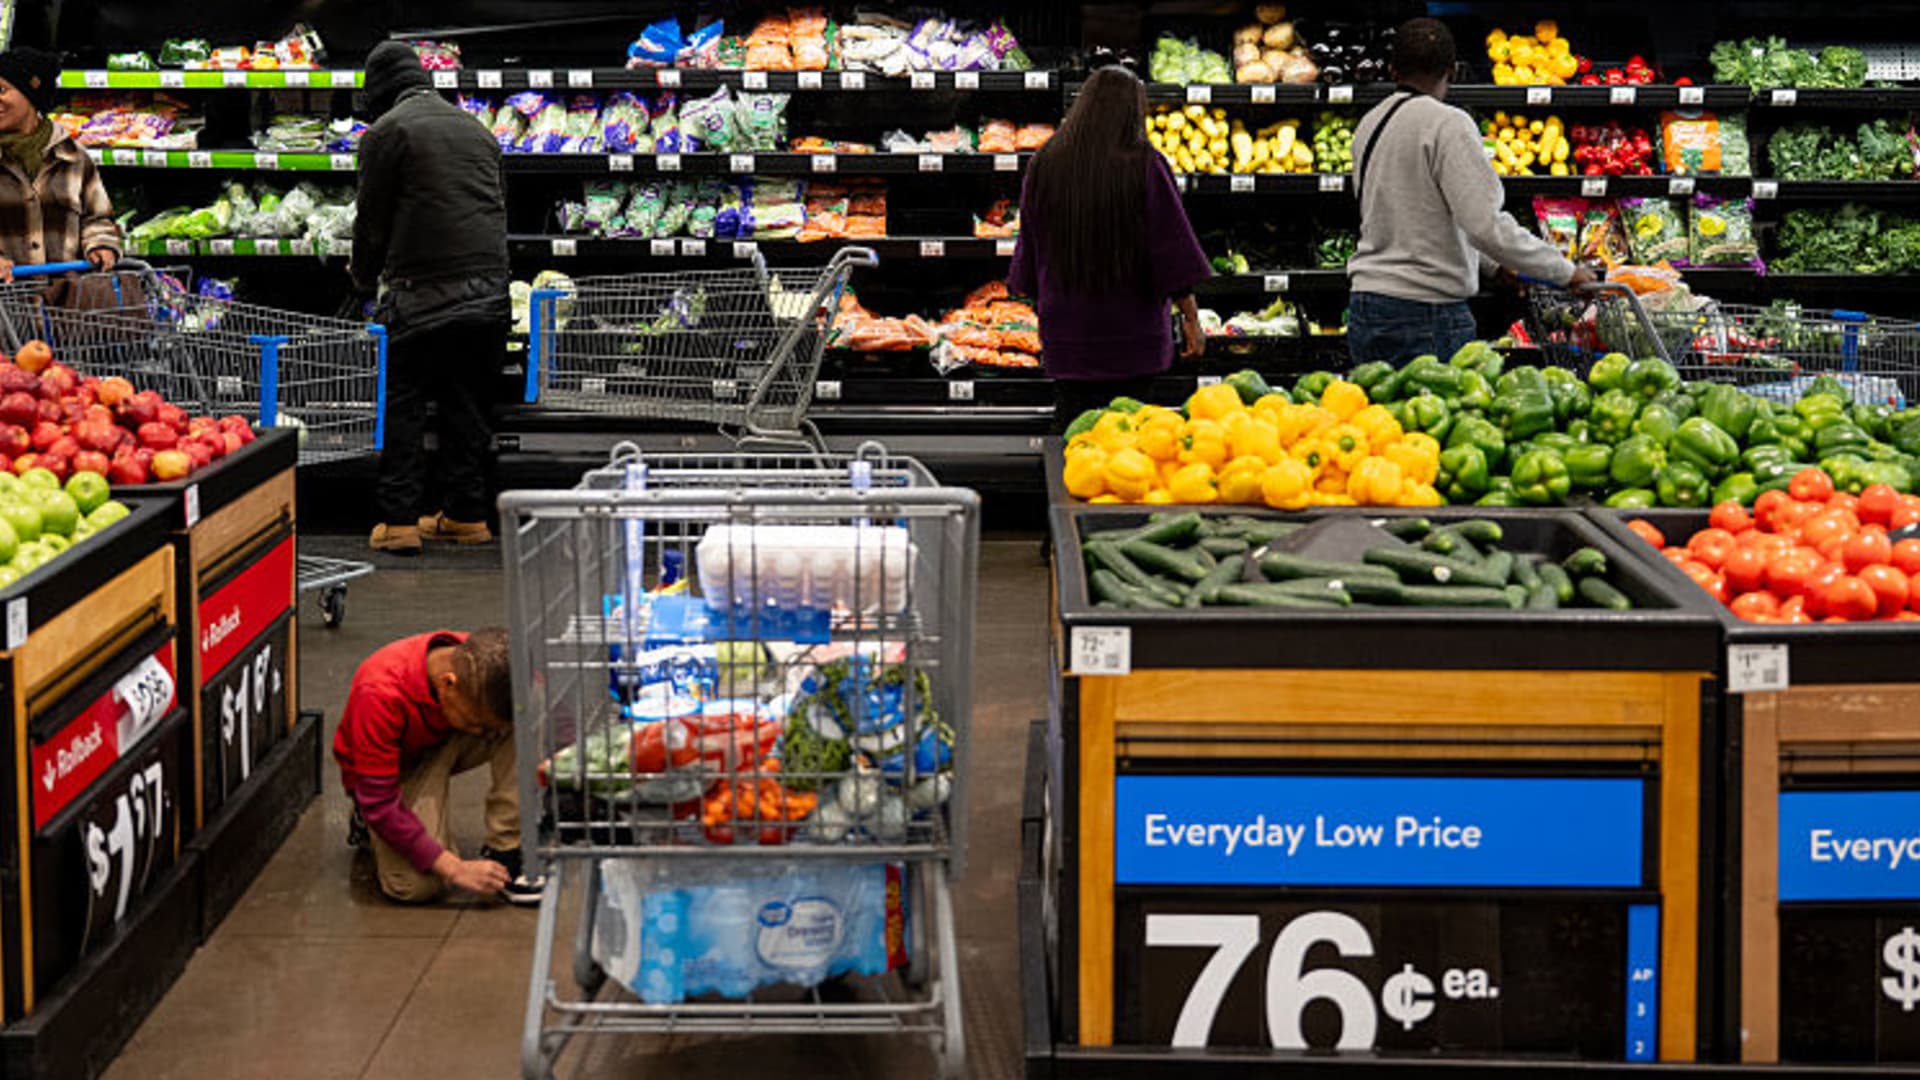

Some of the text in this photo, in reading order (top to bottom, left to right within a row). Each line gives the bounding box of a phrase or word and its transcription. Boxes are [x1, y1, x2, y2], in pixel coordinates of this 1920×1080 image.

[57, 721, 102, 779] Rollback
[1145, 813, 1482, 856] Everyday Low Price
[1442, 967, 1499, 998] ea.
